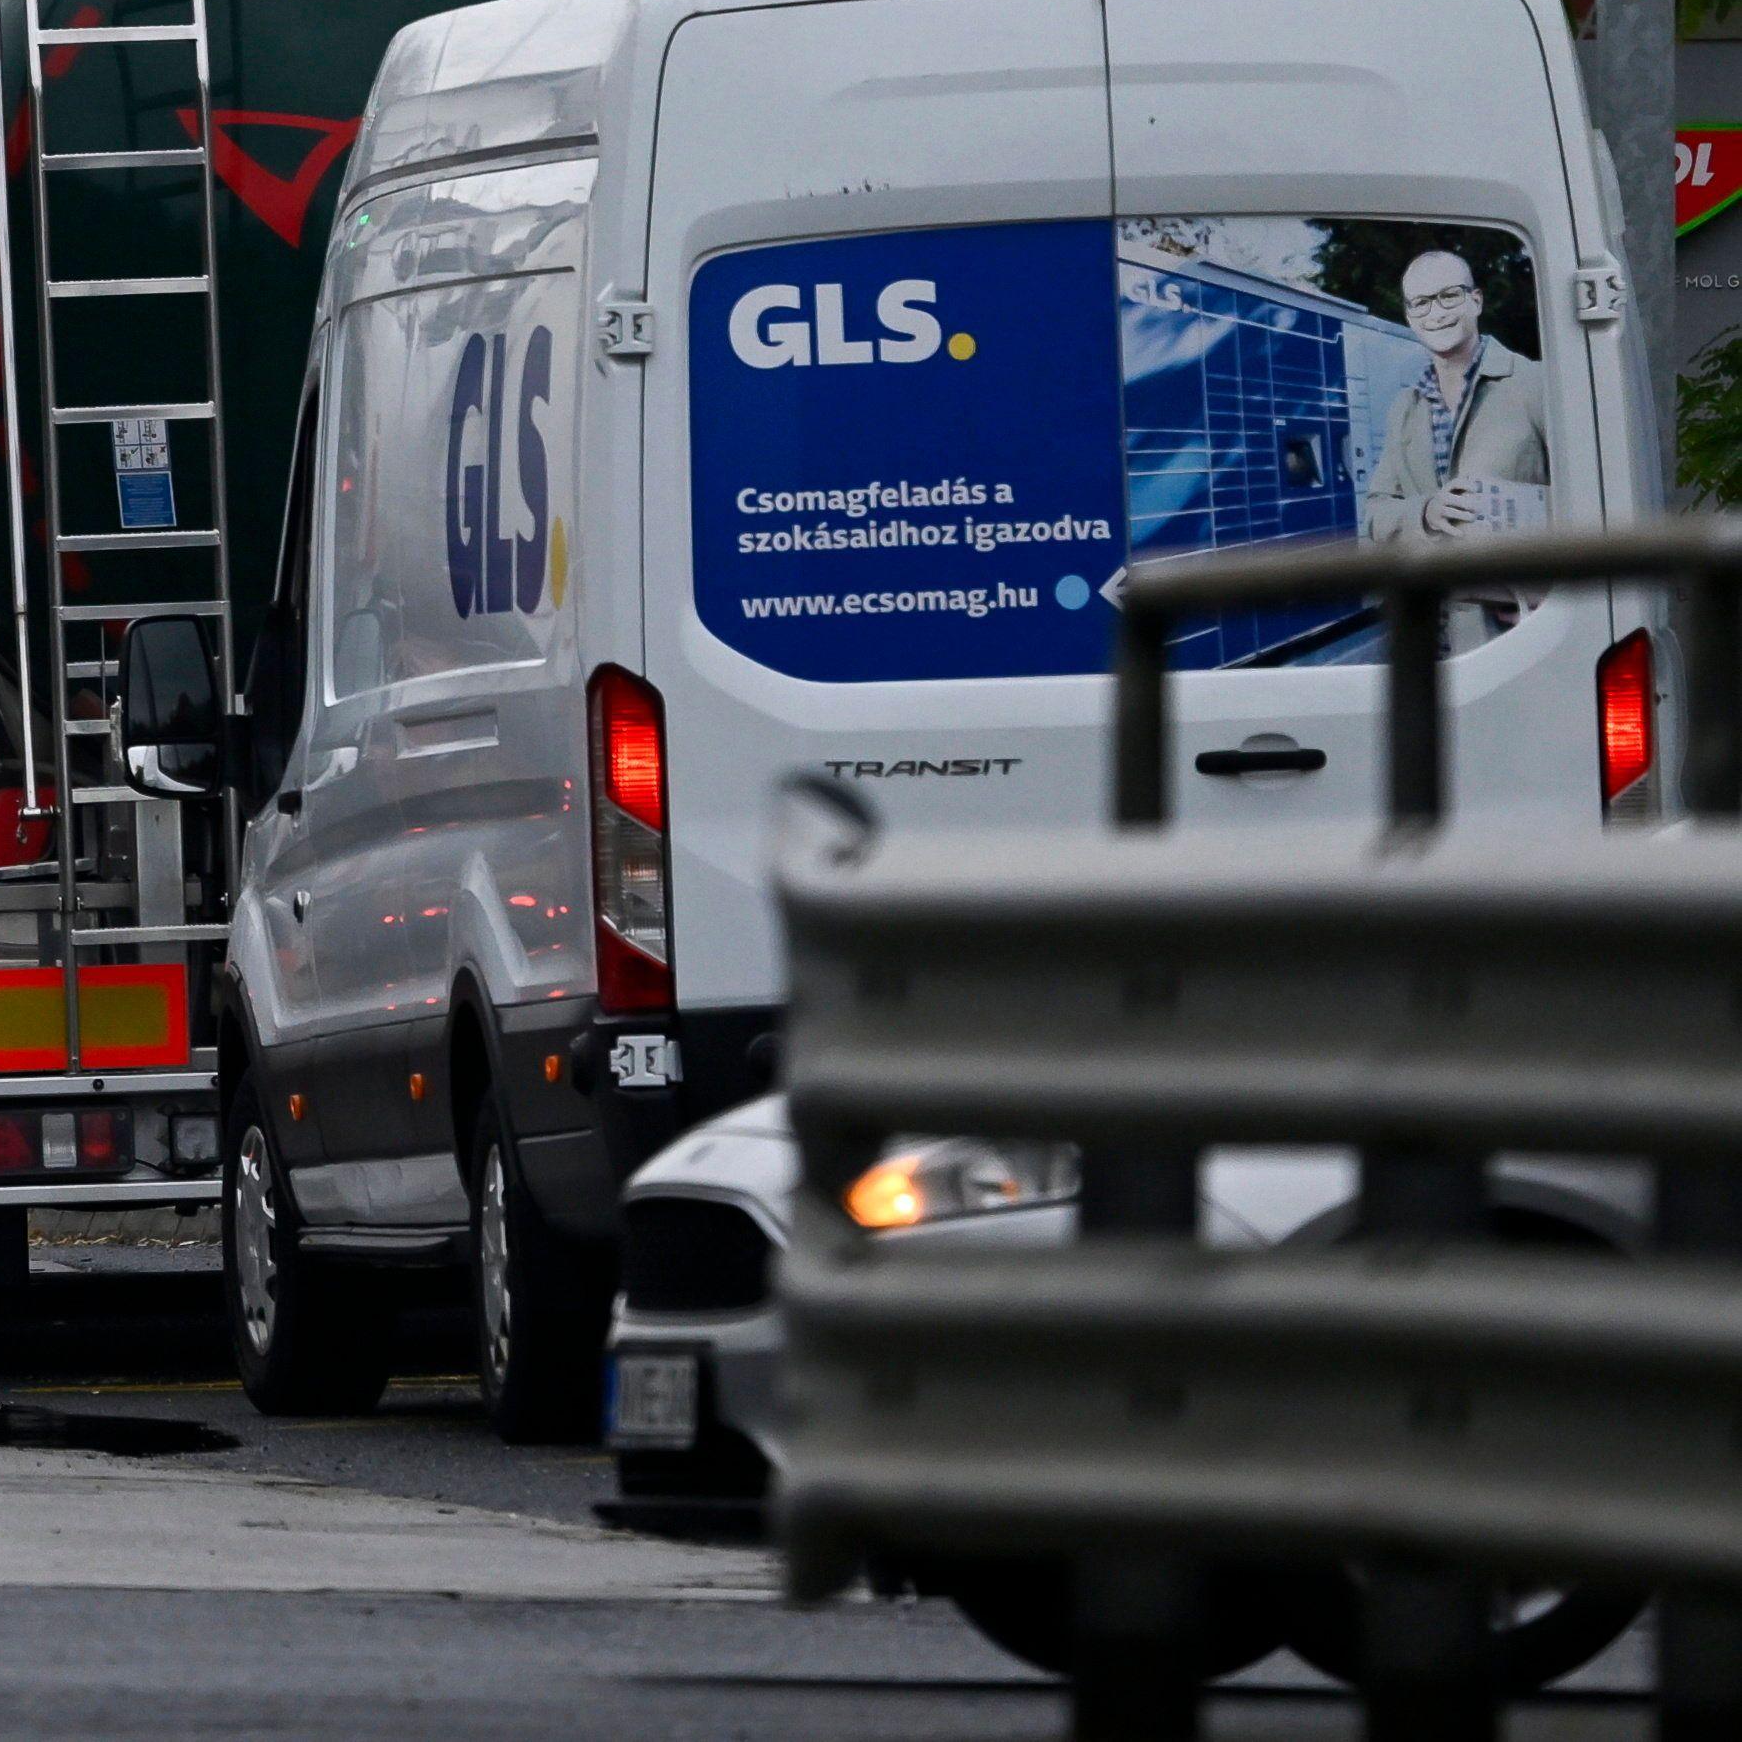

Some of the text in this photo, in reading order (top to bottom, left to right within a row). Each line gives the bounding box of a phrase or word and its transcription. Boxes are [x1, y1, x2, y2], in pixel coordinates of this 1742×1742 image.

[1685, 274, 1723, 289] MOL
[736, 476, 1015, 518] Csomagfeladás a
[738, 514, 1112, 554] szokásaidhoz igazodva
[741, 581, 1039, 619] www.ecsomag.hu
[824, 757, 1023, 778] TRANSIT
